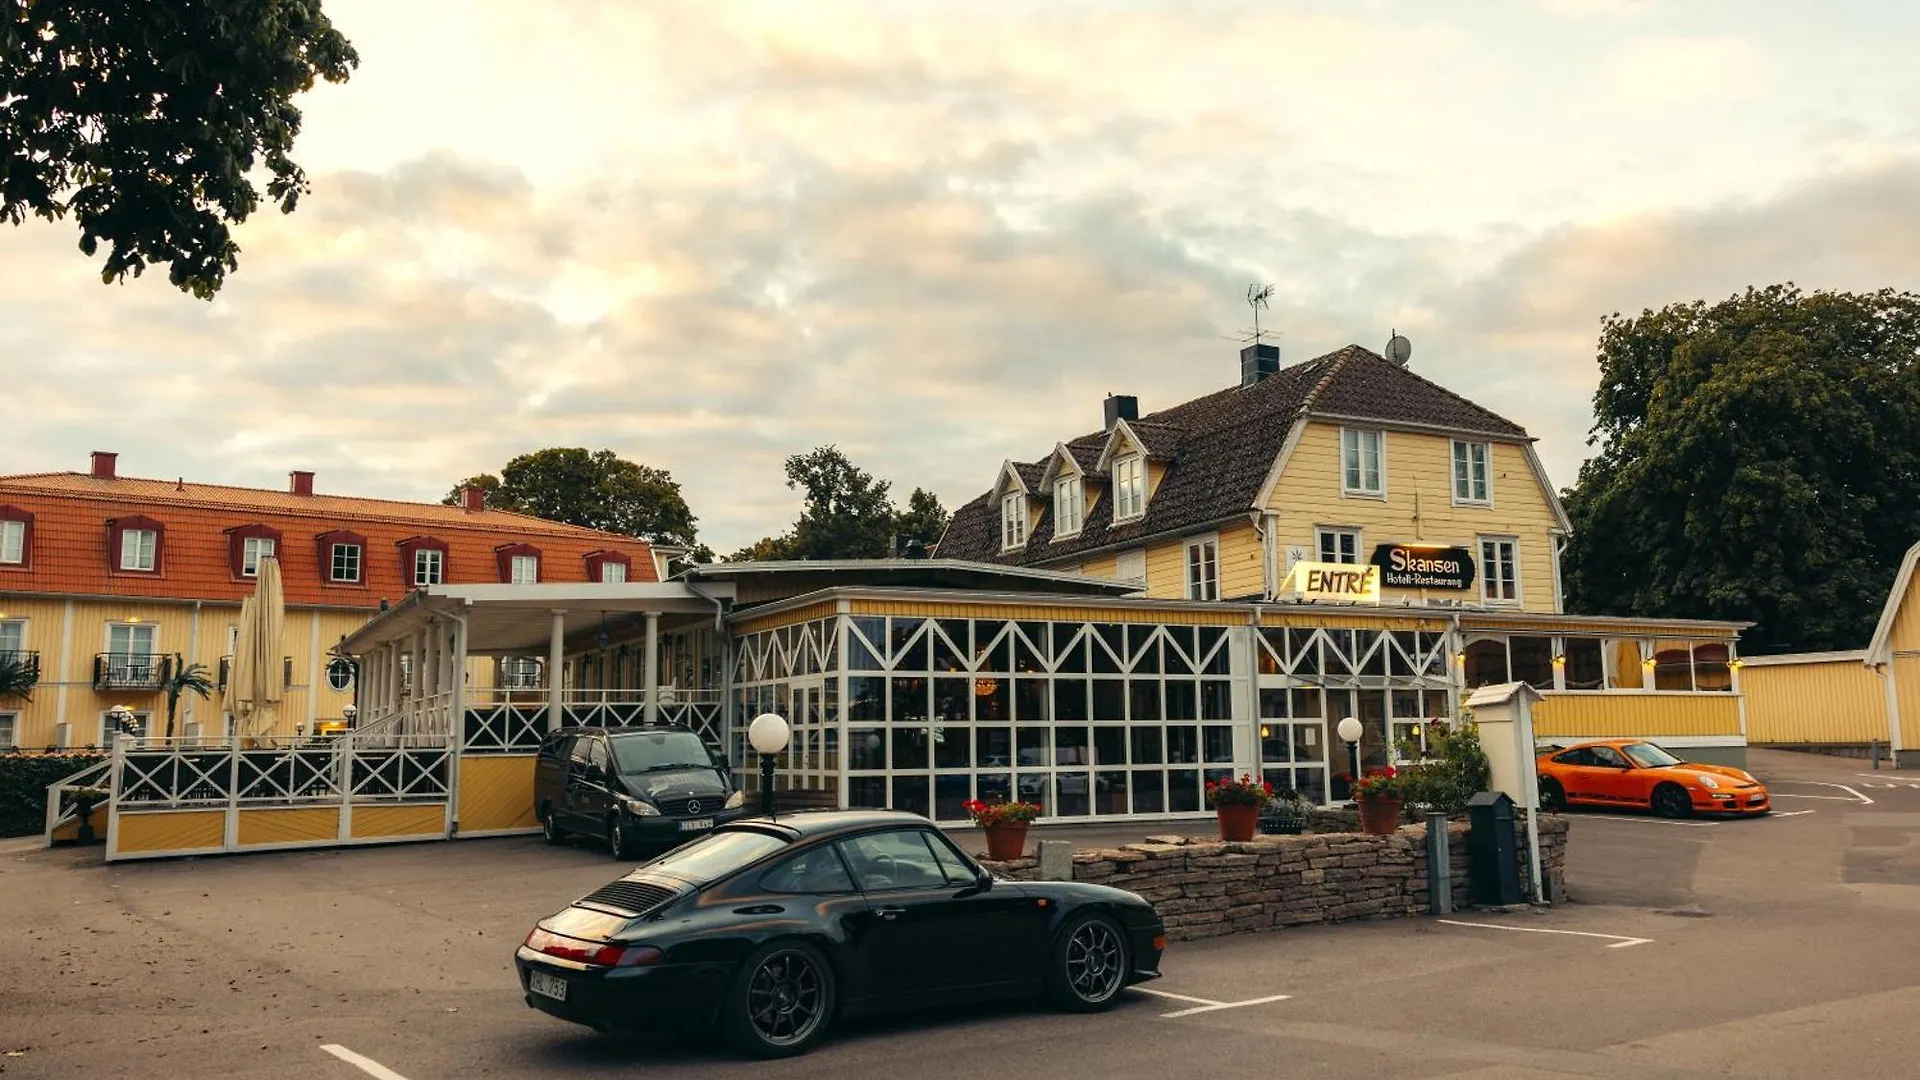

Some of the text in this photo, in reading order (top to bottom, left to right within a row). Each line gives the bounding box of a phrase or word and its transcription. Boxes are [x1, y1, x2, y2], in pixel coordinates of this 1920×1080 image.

[1390, 548, 1460, 573] Skansen
[1307, 567, 1374, 594] ENTRÉ
[1386, 572, 1463, 588] Hotell-Restaurang
